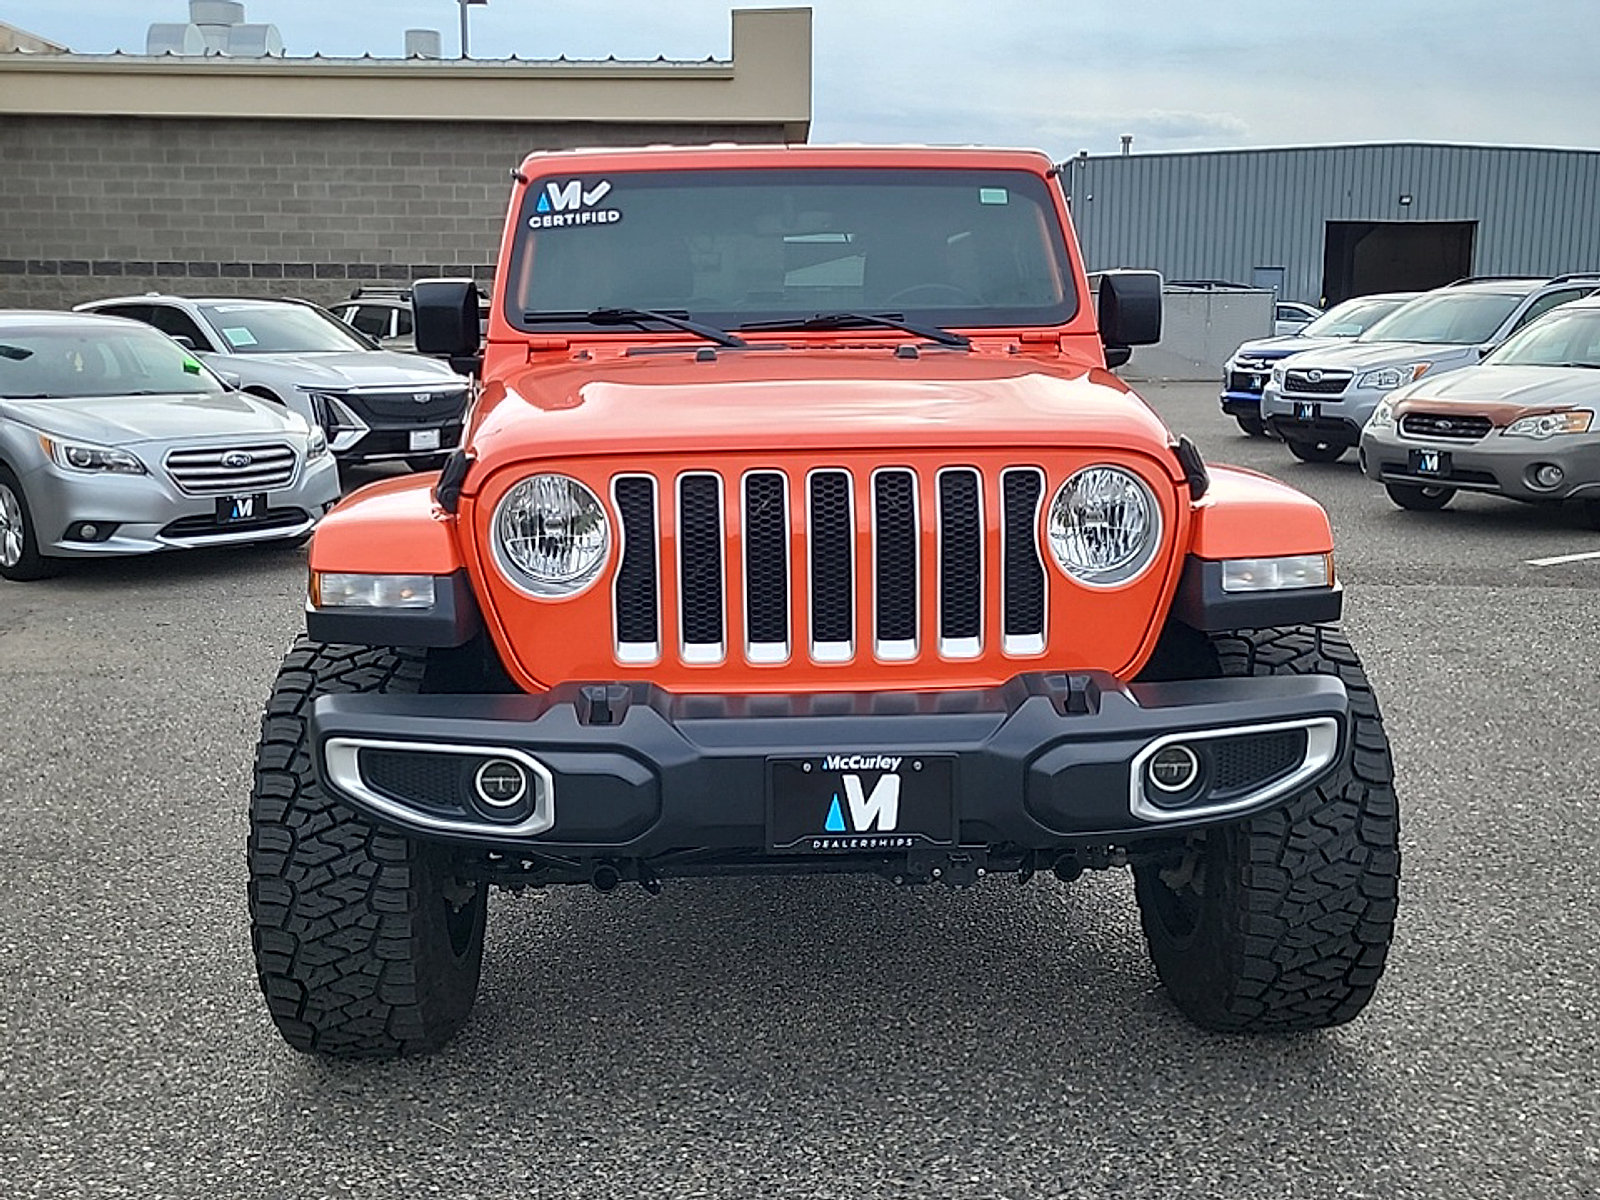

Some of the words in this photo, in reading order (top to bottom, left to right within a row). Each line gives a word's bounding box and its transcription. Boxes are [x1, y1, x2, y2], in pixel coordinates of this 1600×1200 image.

[528, 210, 620, 228] CERTIFIED
[822, 754, 902, 772] McCurley
[812, 838, 914, 849] DEALERSHIPS
